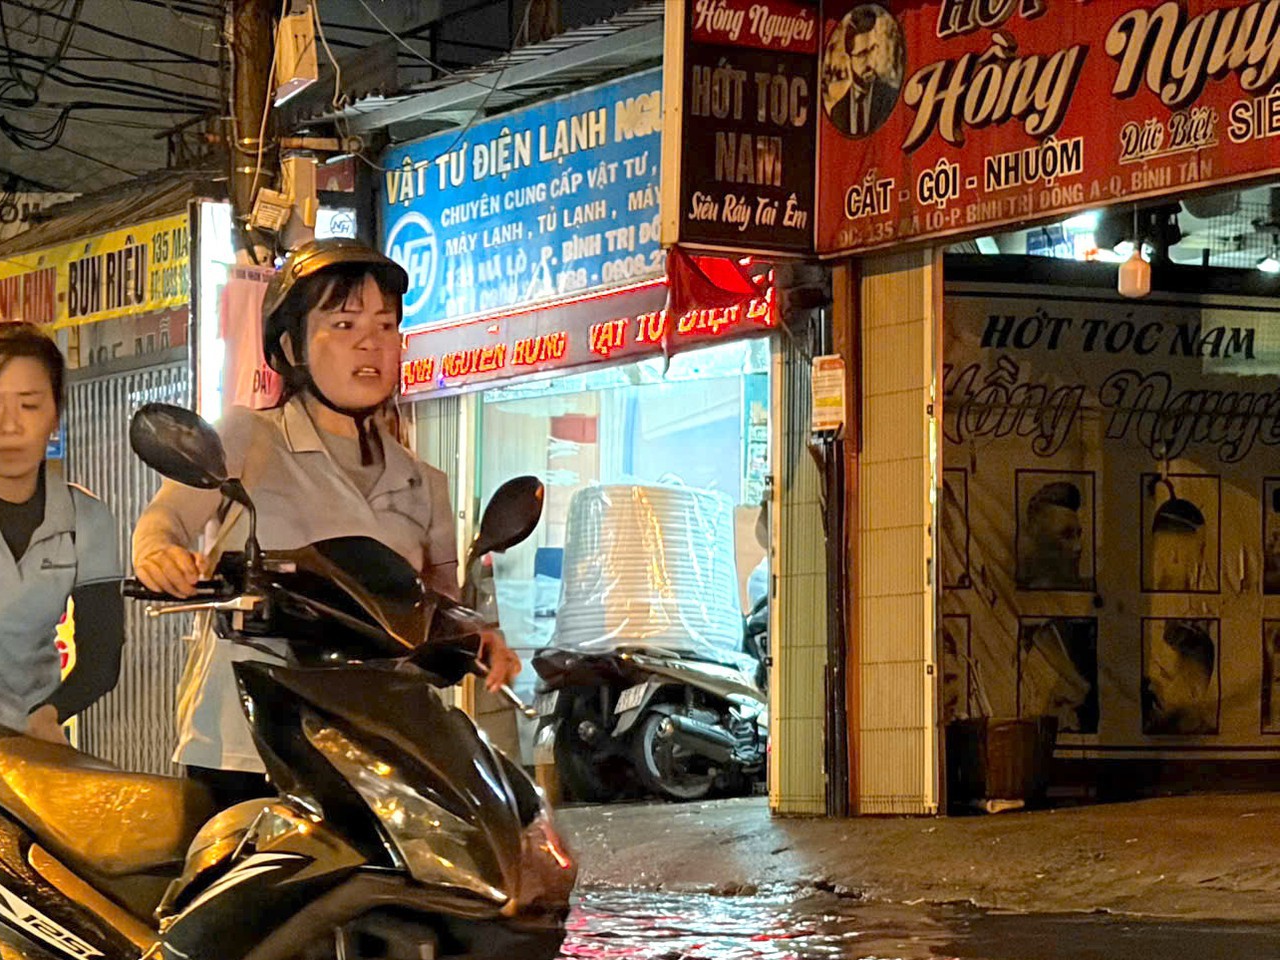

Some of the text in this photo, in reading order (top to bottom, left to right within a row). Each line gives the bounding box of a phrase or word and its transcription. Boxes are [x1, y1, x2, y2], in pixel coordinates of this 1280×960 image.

[690, 57, 809, 127] HỚT TÓC
[902, 32, 1088, 153] Hồng
[385, 156, 430, 207] VẬT
[435, 141, 468, 191] TƯ
[473, 126, 532, 181] ĐIỆN
[538, 108, 607, 166] LẠNH
[713, 131, 783, 187] NAM
[844, 135, 1084, 220] CẮT GỘI NHUỘM
[1178, 155, 1213, 184] TÂN
[440, 194, 500, 228] CHUYÊN
[503, 183, 547, 210] CUNG
[549, 167, 584, 199] CẤP
[587, 162, 619, 191] VẬT
[688, 190, 808, 232] Siêu Ráy Tai Êm
[151, 231, 170, 265] 135
[445, 230, 479, 257] MÁY
[537, 205, 558, 235] TỦ
[561, 232, 602, 264] BÌNH
[605, 225, 635, 252] TRỊ
[68, 243, 103, 319] BÚN
[105, 233, 149, 312] RIÊU
[980, 306, 1257, 360] HỚT TÓC NAM
